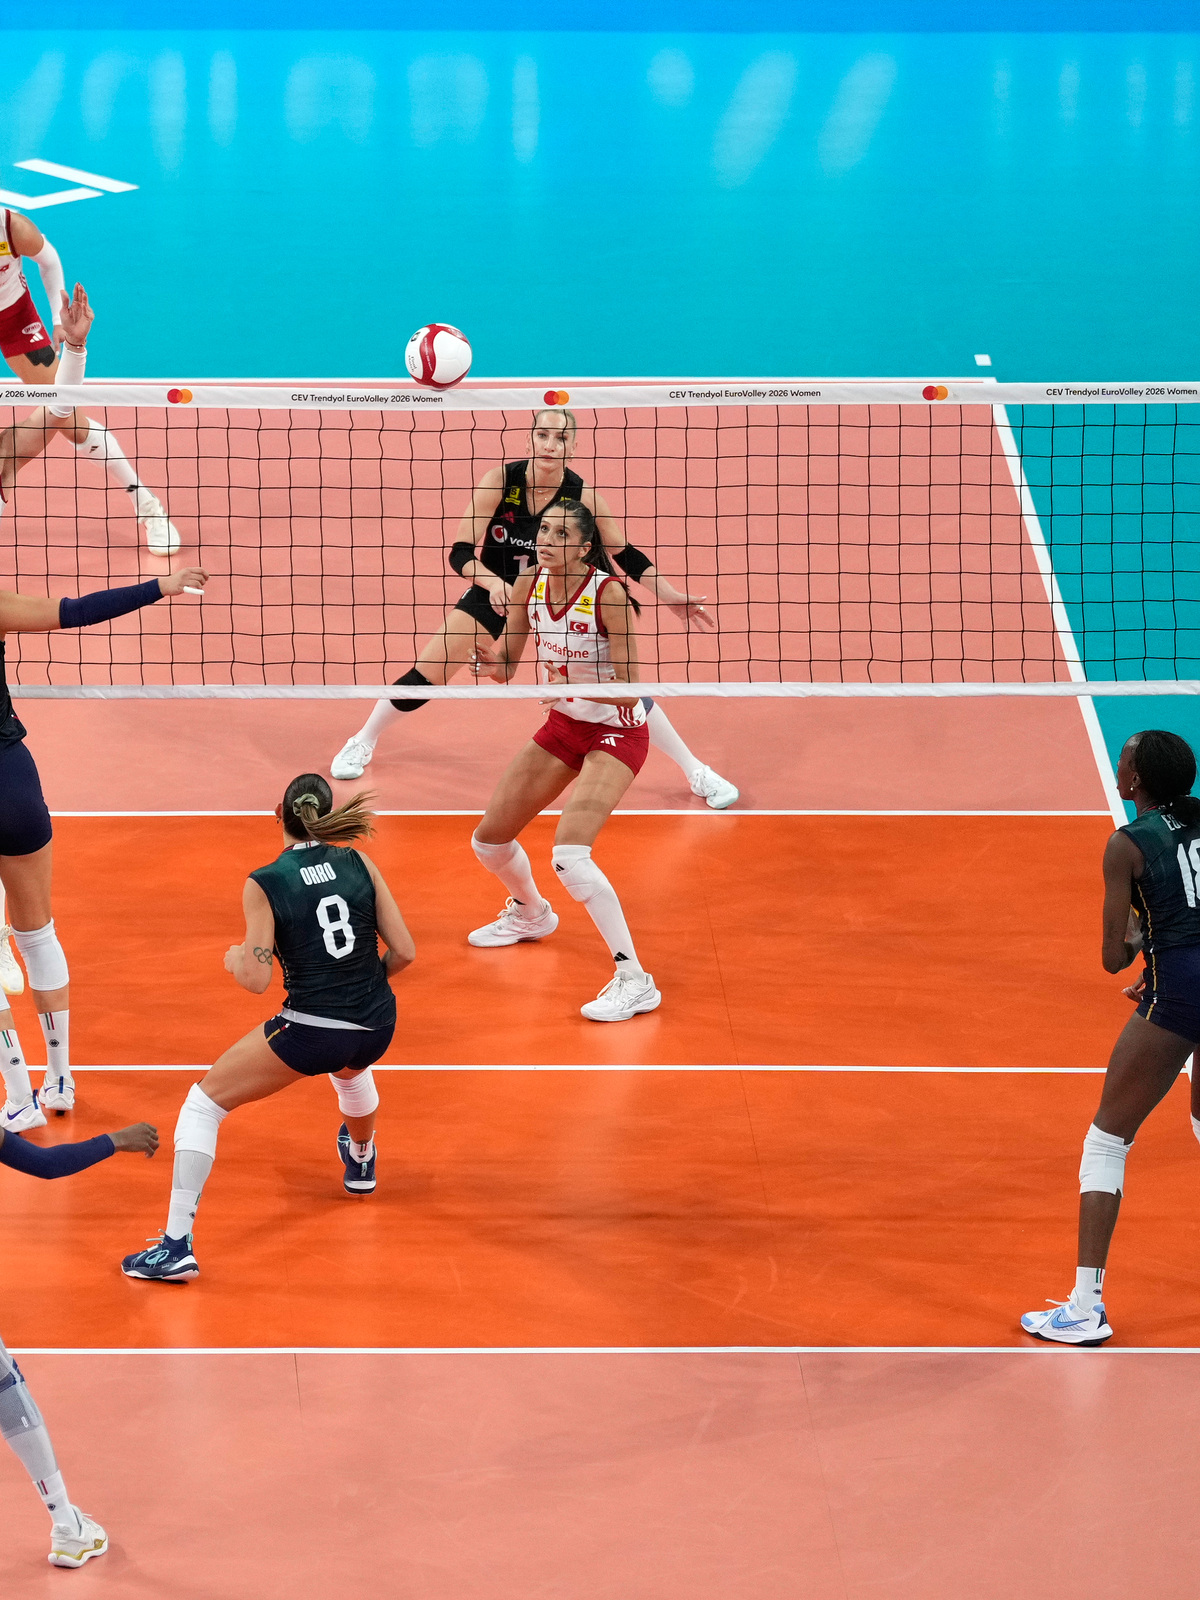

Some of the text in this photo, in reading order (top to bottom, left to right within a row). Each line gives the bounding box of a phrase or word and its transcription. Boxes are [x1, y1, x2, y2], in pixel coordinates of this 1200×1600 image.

[5, 390, 25, 398] 2026
[27, 390, 58, 398] Women
[669, 389, 821, 399] CEV Trendyol EuroVolley 2026 Women
[1046, 388, 1063, 396] CEV
[1065, 388, 1100, 397] Trendyol
[1101, 388, 1144, 397] EuroVolley
[1145, 388, 1165, 396] 2026
[291, 393, 443, 404] CEV Trendyol EuroVolley 2026 Women
[542, 638, 589, 659] vodafone
[299, 862, 337, 886] ORRO
[315, 894, 356, 960] 8
